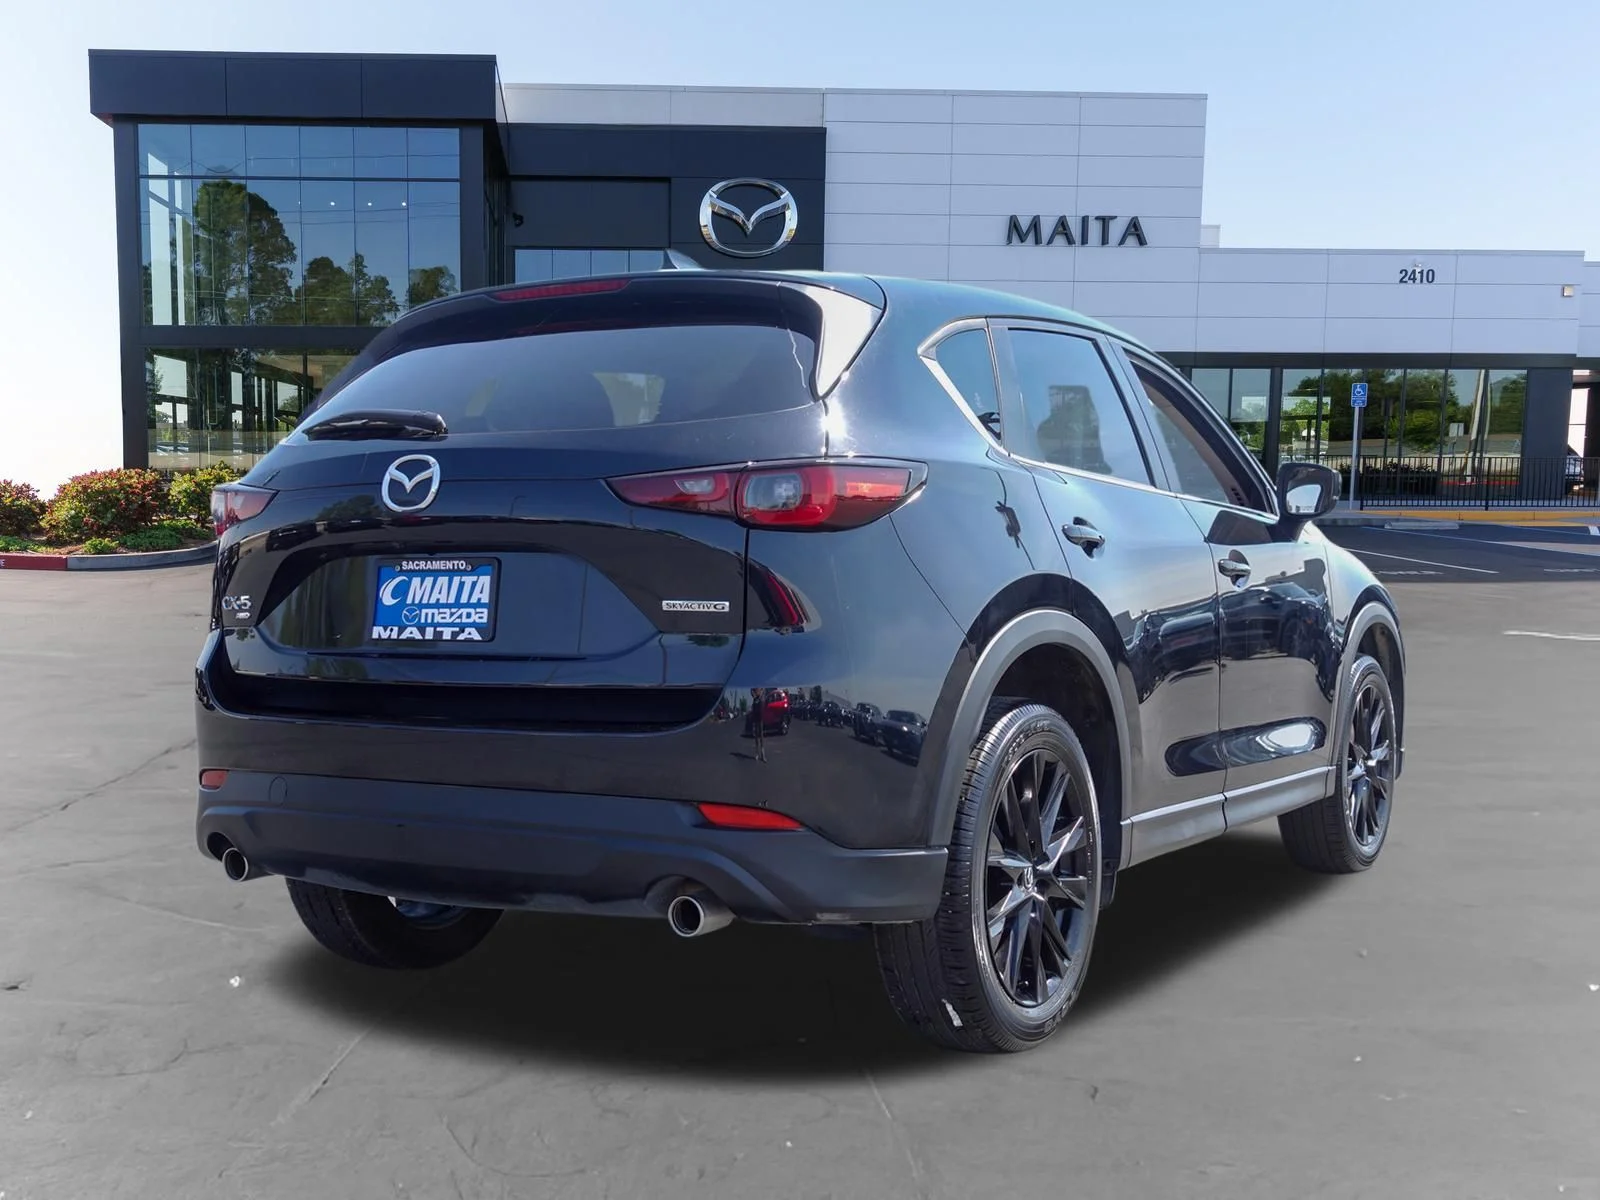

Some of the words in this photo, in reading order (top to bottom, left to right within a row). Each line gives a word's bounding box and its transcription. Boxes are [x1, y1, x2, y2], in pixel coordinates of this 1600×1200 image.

[1006, 215, 1148, 246] MAITA
[1399, 269, 1435, 284] 2410
[401, 560, 466, 571] SACRAMENTO
[406, 576, 491, 604] MAITA
[372, 626, 482, 640] MAITA
